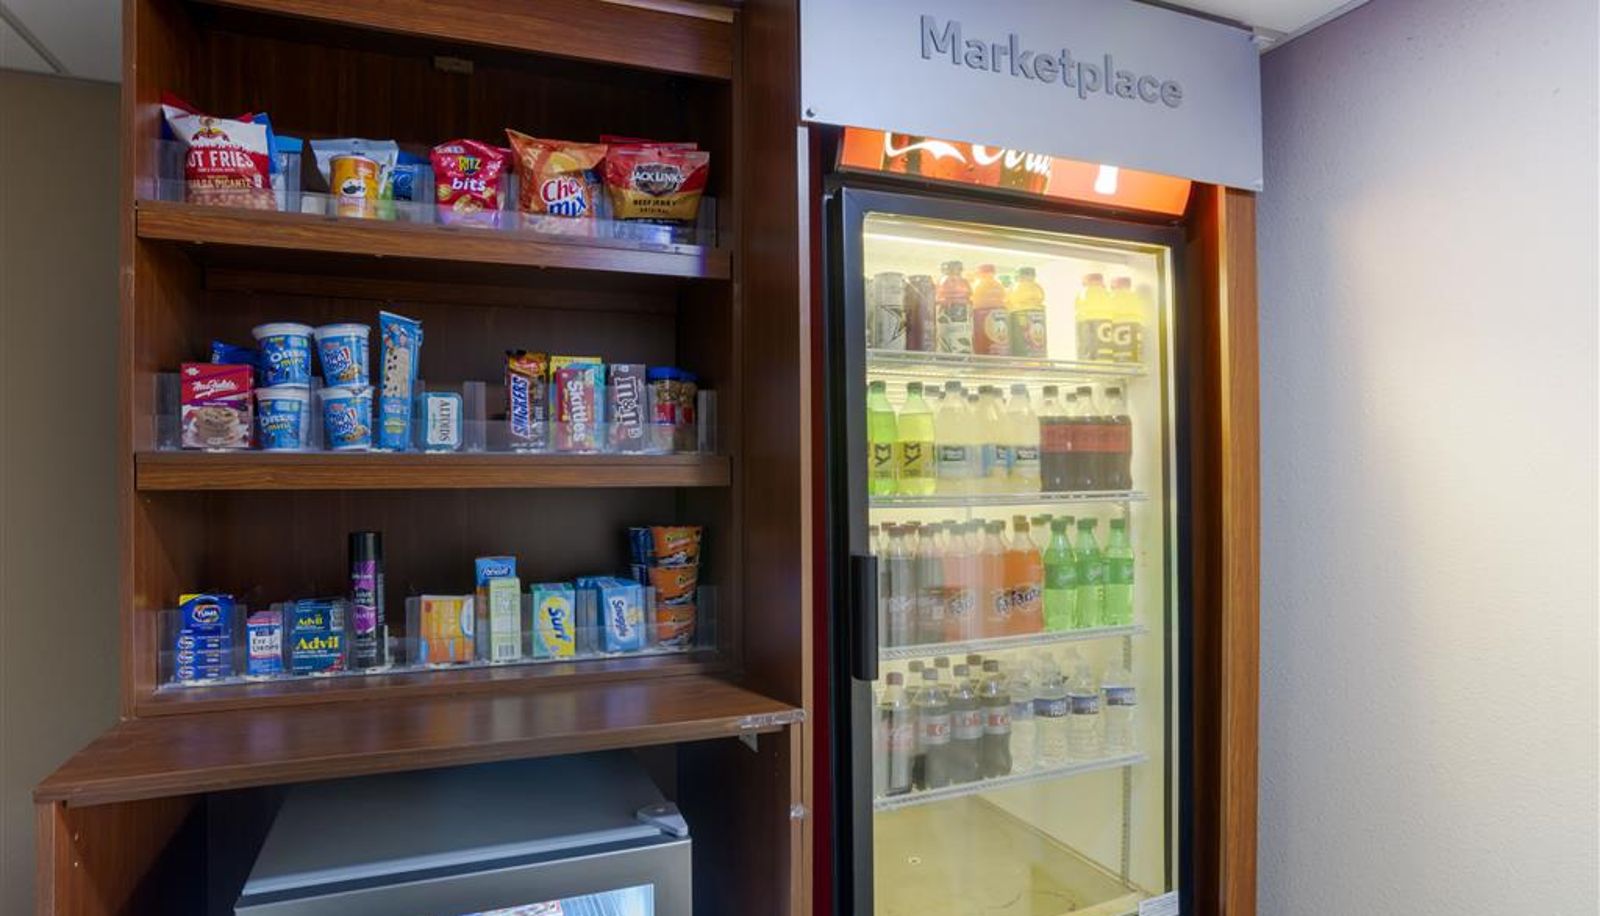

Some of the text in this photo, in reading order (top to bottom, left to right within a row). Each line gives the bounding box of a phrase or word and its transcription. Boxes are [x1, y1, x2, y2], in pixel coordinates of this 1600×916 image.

[920, 15, 1183, 107] Marketplace
[209, 150, 254, 168] FRIES
[452, 177, 486, 192] bits
[440, 399, 452, 442] ALTOIDS
[512, 376, 530, 436] SNICKERS
[567, 380, 589, 442] Skittles
[298, 615, 323, 626] Advil
[547, 607, 572, 643] Surf
[612, 599, 629, 638] Snuggle
[295, 636, 340, 651] Advil
